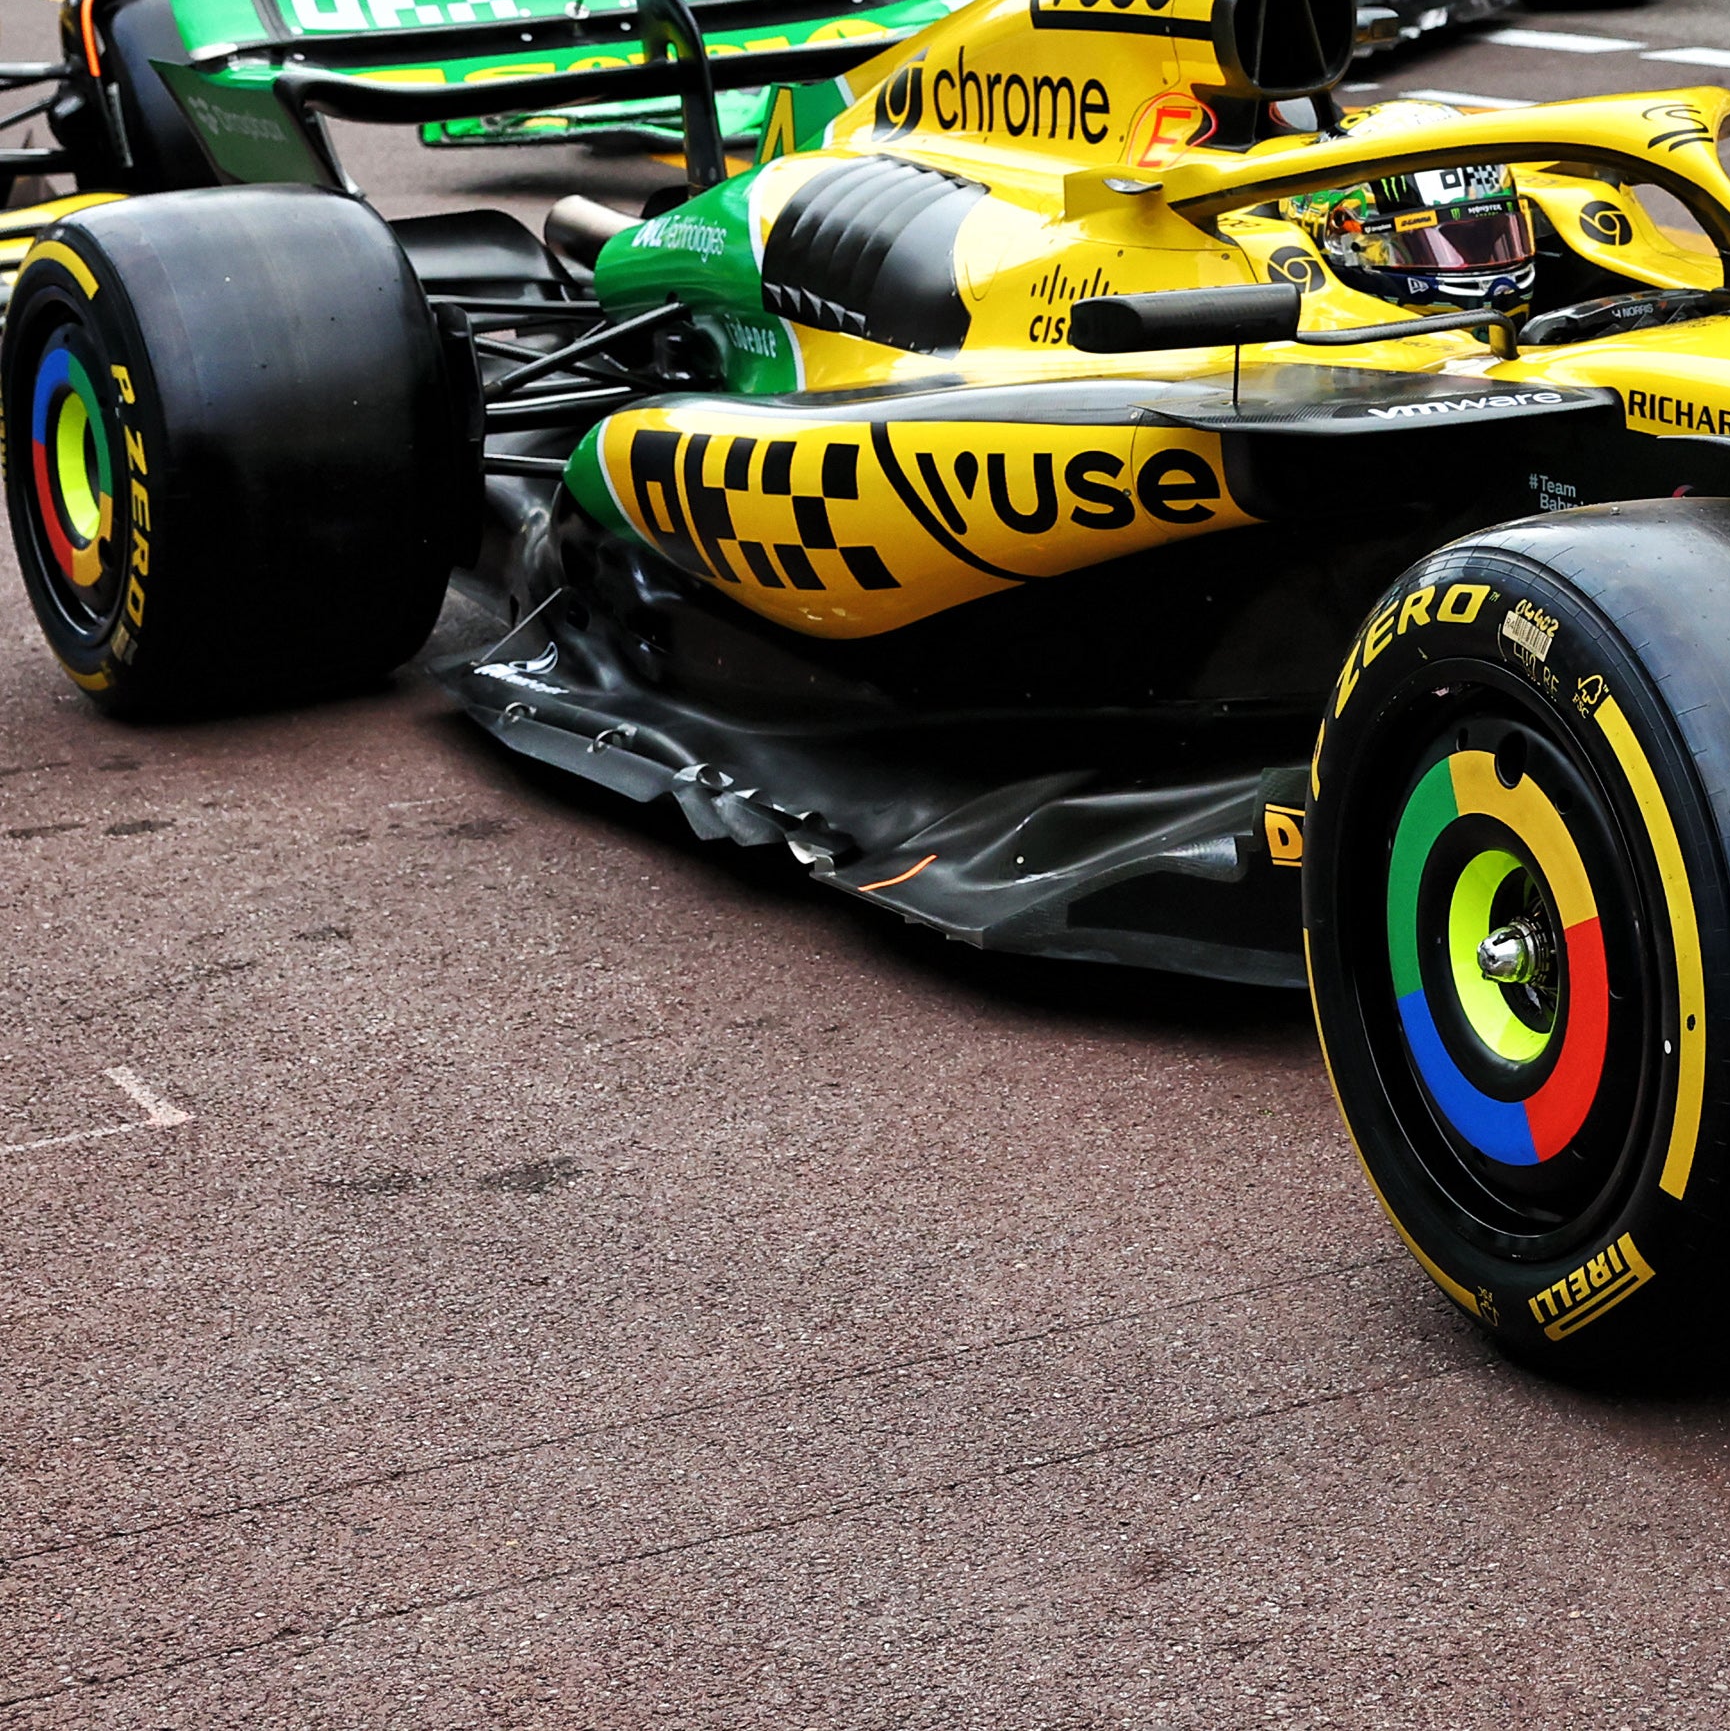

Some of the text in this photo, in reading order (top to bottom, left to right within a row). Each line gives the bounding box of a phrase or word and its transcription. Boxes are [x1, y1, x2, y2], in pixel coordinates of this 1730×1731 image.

[933, 46, 1111, 145] chrome
[1622, 304, 1653, 318] NORRIS
[1368, 391, 1562, 420] vmware
[111, 364, 136, 405] P
[124, 424, 151, 628] ZERO
[630, 429, 902, 591] OKX
[1334, 583, 1491, 719] ZERO
[1527, 1231, 1657, 1342] PIRELLI
